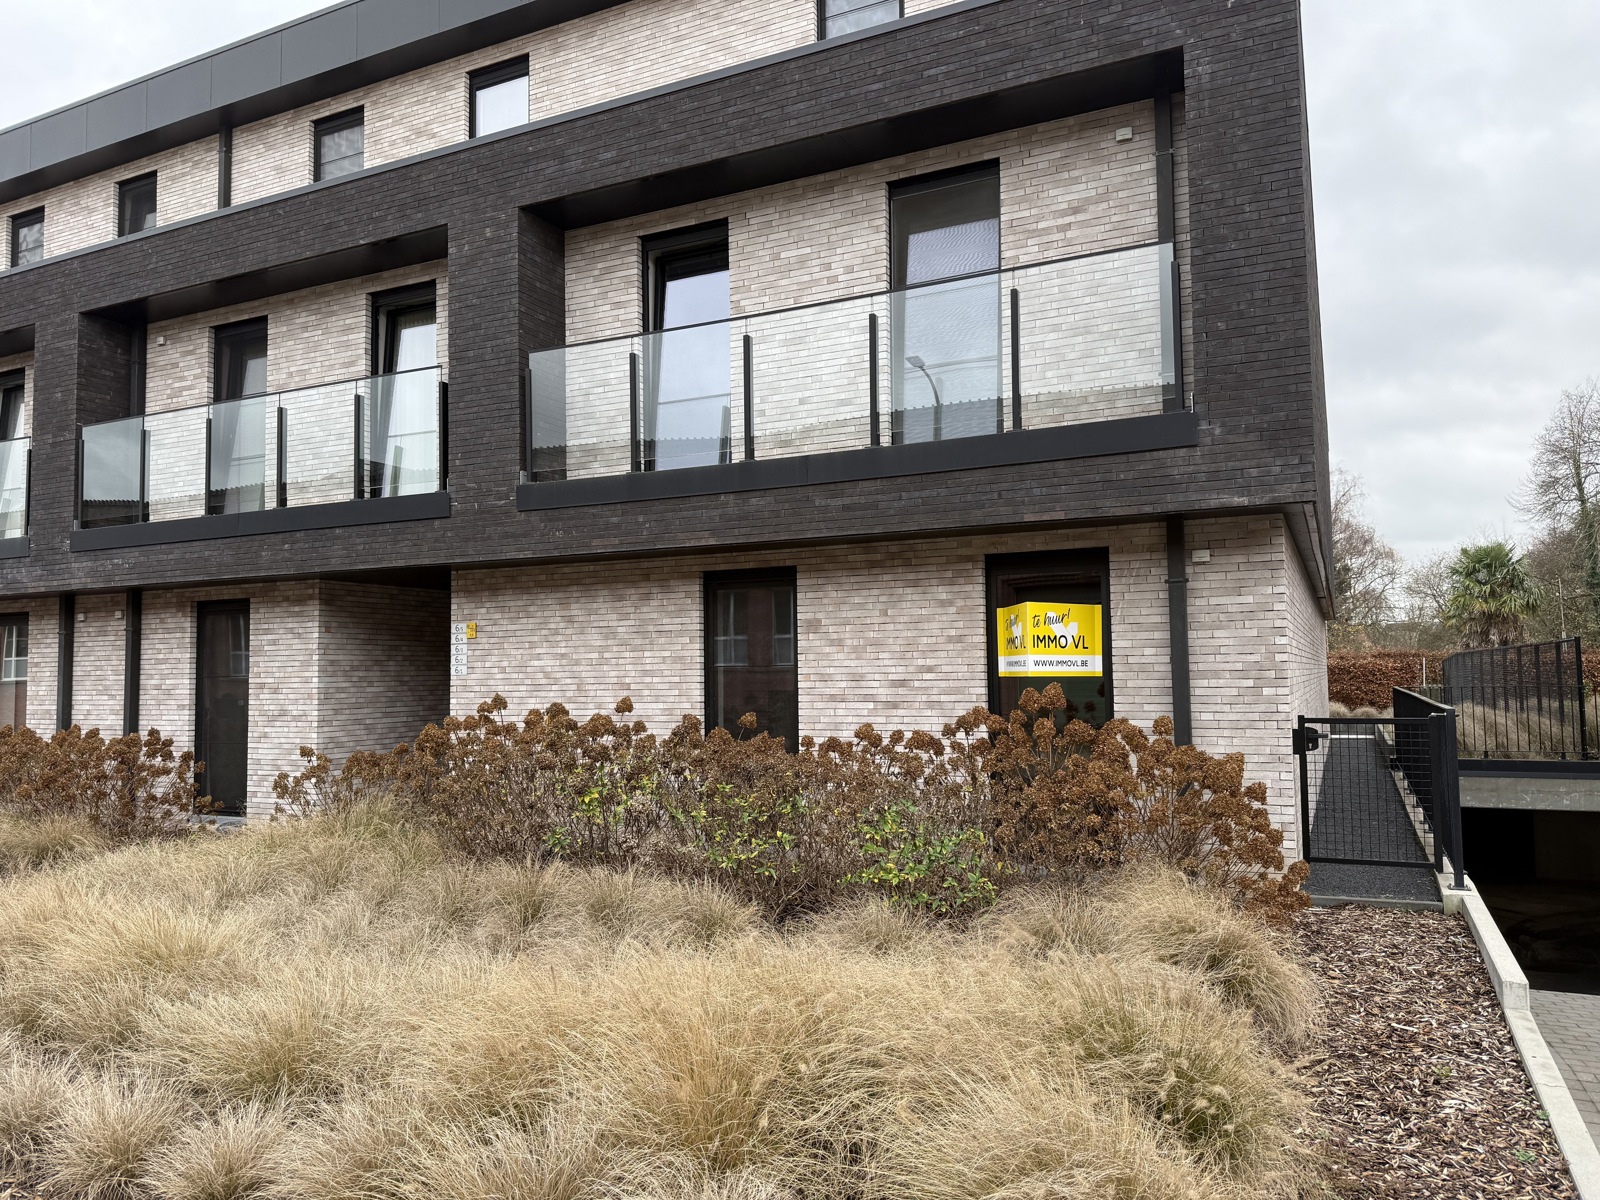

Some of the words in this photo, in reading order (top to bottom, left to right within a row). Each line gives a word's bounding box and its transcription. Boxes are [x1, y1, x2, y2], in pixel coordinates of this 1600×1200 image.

[1032, 614, 1041, 628] te
[1043, 608, 1071, 626] huur!
[1032, 634, 1068, 649] IMMO
[1071, 635, 1089, 649] VL
[1033, 659, 1089, 668] WWW.IMMOVL.BE
